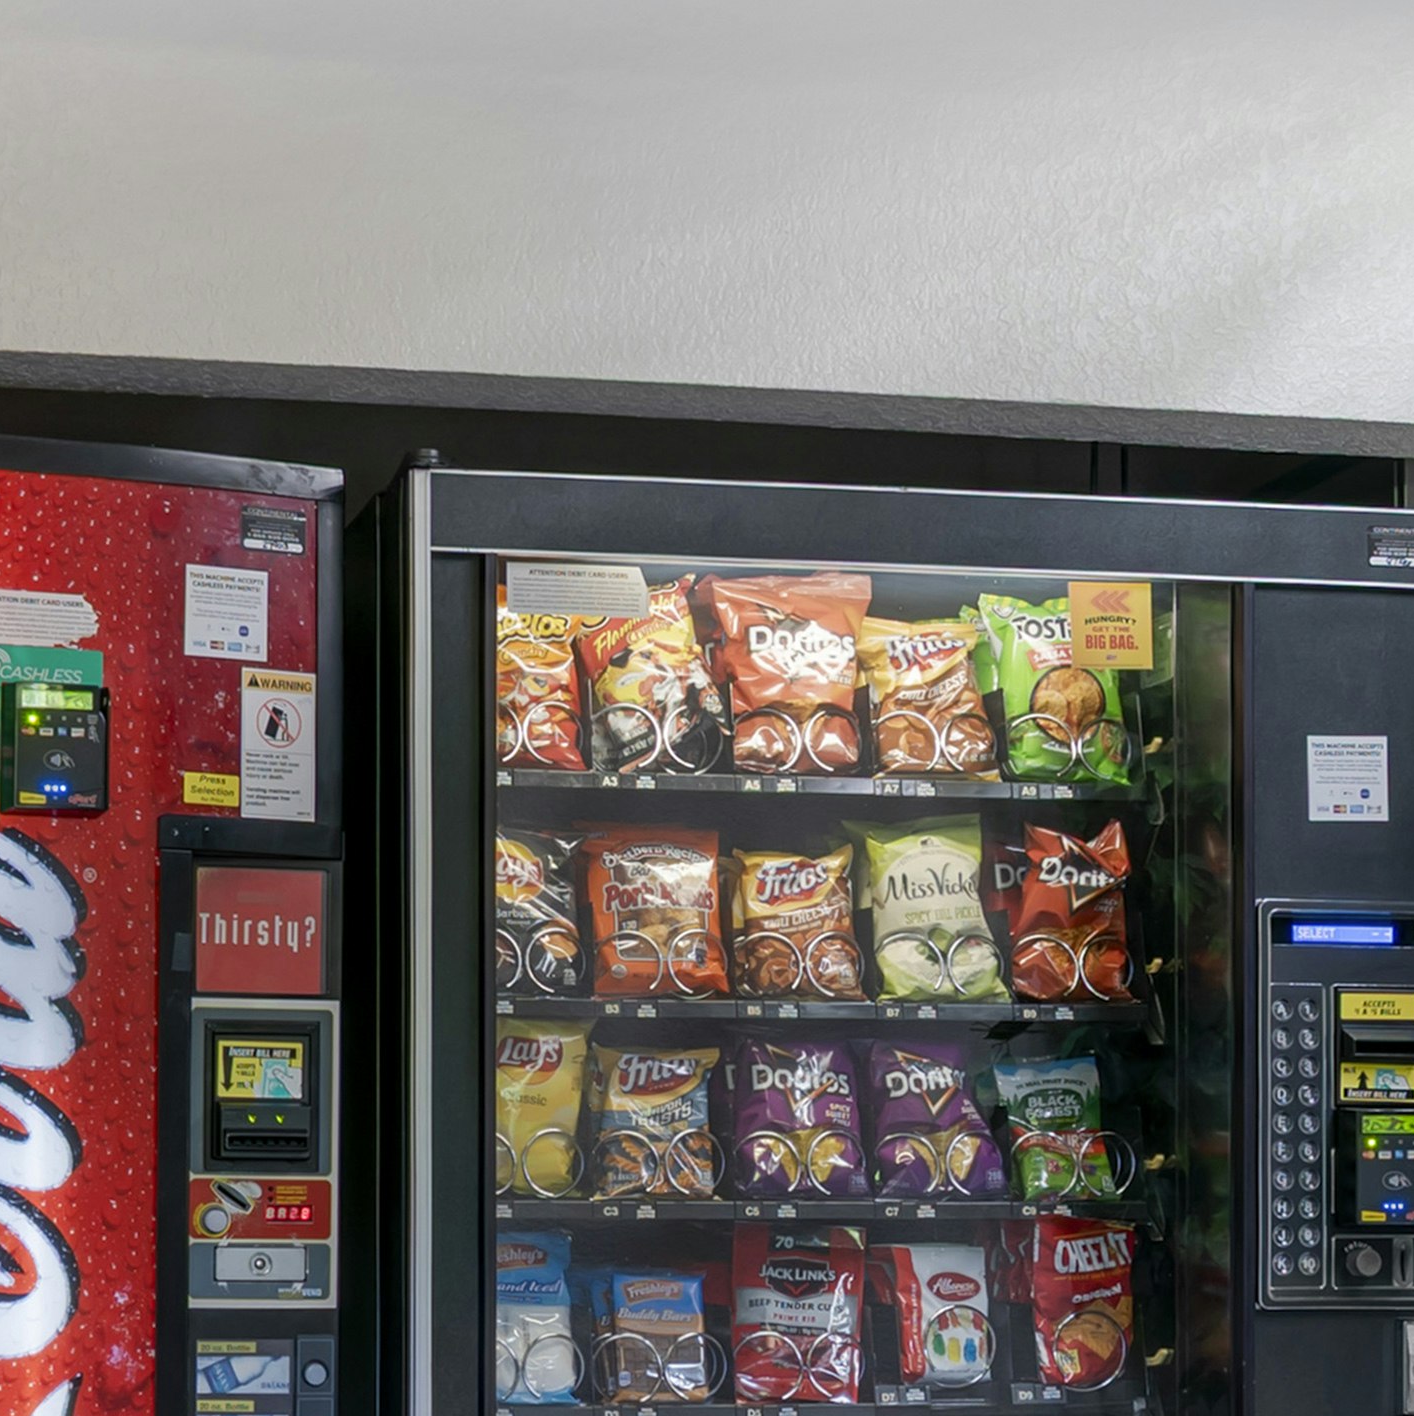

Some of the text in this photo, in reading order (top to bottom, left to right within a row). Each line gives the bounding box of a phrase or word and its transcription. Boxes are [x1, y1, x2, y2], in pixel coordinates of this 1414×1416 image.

[205, 573, 236, 582] MACHINE
[237, 577, 264, 586] ACCEPTS
[528, 568, 629, 580] ATTENTION DEBIT CARD USERS
[192, 581, 224, 589] CASHLESS
[20, 597, 40, 605] DEBIT
[41, 598, 62, 607] CARD
[63, 600, 84, 608] USERS
[1084, 615, 1137, 626] HUNGRY?
[1085, 634, 1139, 650] BIG BAG.
[0, 665, 83, 684] CASHLESS
[260, 677, 313, 693] WARNING
[199, 774, 226, 785] Press
[602, 776, 619, 788] A3
[744, 779, 761, 791] A5
[190, 785, 235, 797] Selection
[884, 784, 899, 794] A7
[1021, 785, 1037, 796] A9
[756, 860, 828, 905] Fritos
[884, 872, 935, 905] Miss
[603, 881, 655, 913] Pork
[198, 912, 316, 953] Thirsty?
[1297, 927, 1336, 939] SELECT
[605, 1003, 620, 1014] B3
[1276, 1004, 1311, 1015] A 1
[1362, 1000, 1396, 1008] ACCEPTS
[747, 1005, 762, 1015] B5
[886, 1008, 900, 1018] B7
[1380, 1008, 1401, 1016] BILLS
[1277, 1033, 1285, 1044] B
[1276, 1061, 1286, 1073] C
[1277, 1089, 1313, 1100] D 4
[1347, 1089, 1408, 1099] INSERT BILL HERE
[1027, 1094, 1077, 1108] BLACK
[1024, 1104, 1082, 1119] FOREST
[1278, 1117, 1286, 1128] E
[1303, 1146, 1312, 1157] 6
[1277, 1174, 1287, 1186] G
[603, 1206, 619, 1217] C3
[745, 1206, 760, 1217] C5
[885, 1206, 900, 1217] C7
[1277, 1203, 1287, 1214] H
[774, 1235, 794, 1249] 70
[1278, 1231, 1286, 1242] J
[1277, 1258, 1315, 1270] K 10
[758, 1263, 836, 1281] JACK LINK'S
[497, 1281, 525, 1293] and
[748, 1298, 844, 1313] BEEF TENDER CUS
[617, 1306, 693, 1323] Buddy Bars
[200, 1343, 211, 1351] 20
[226, 1343, 252, 1351] Bottle
[882, 1392, 896, 1403] D7
[1018, 1390, 1034, 1400] D9
